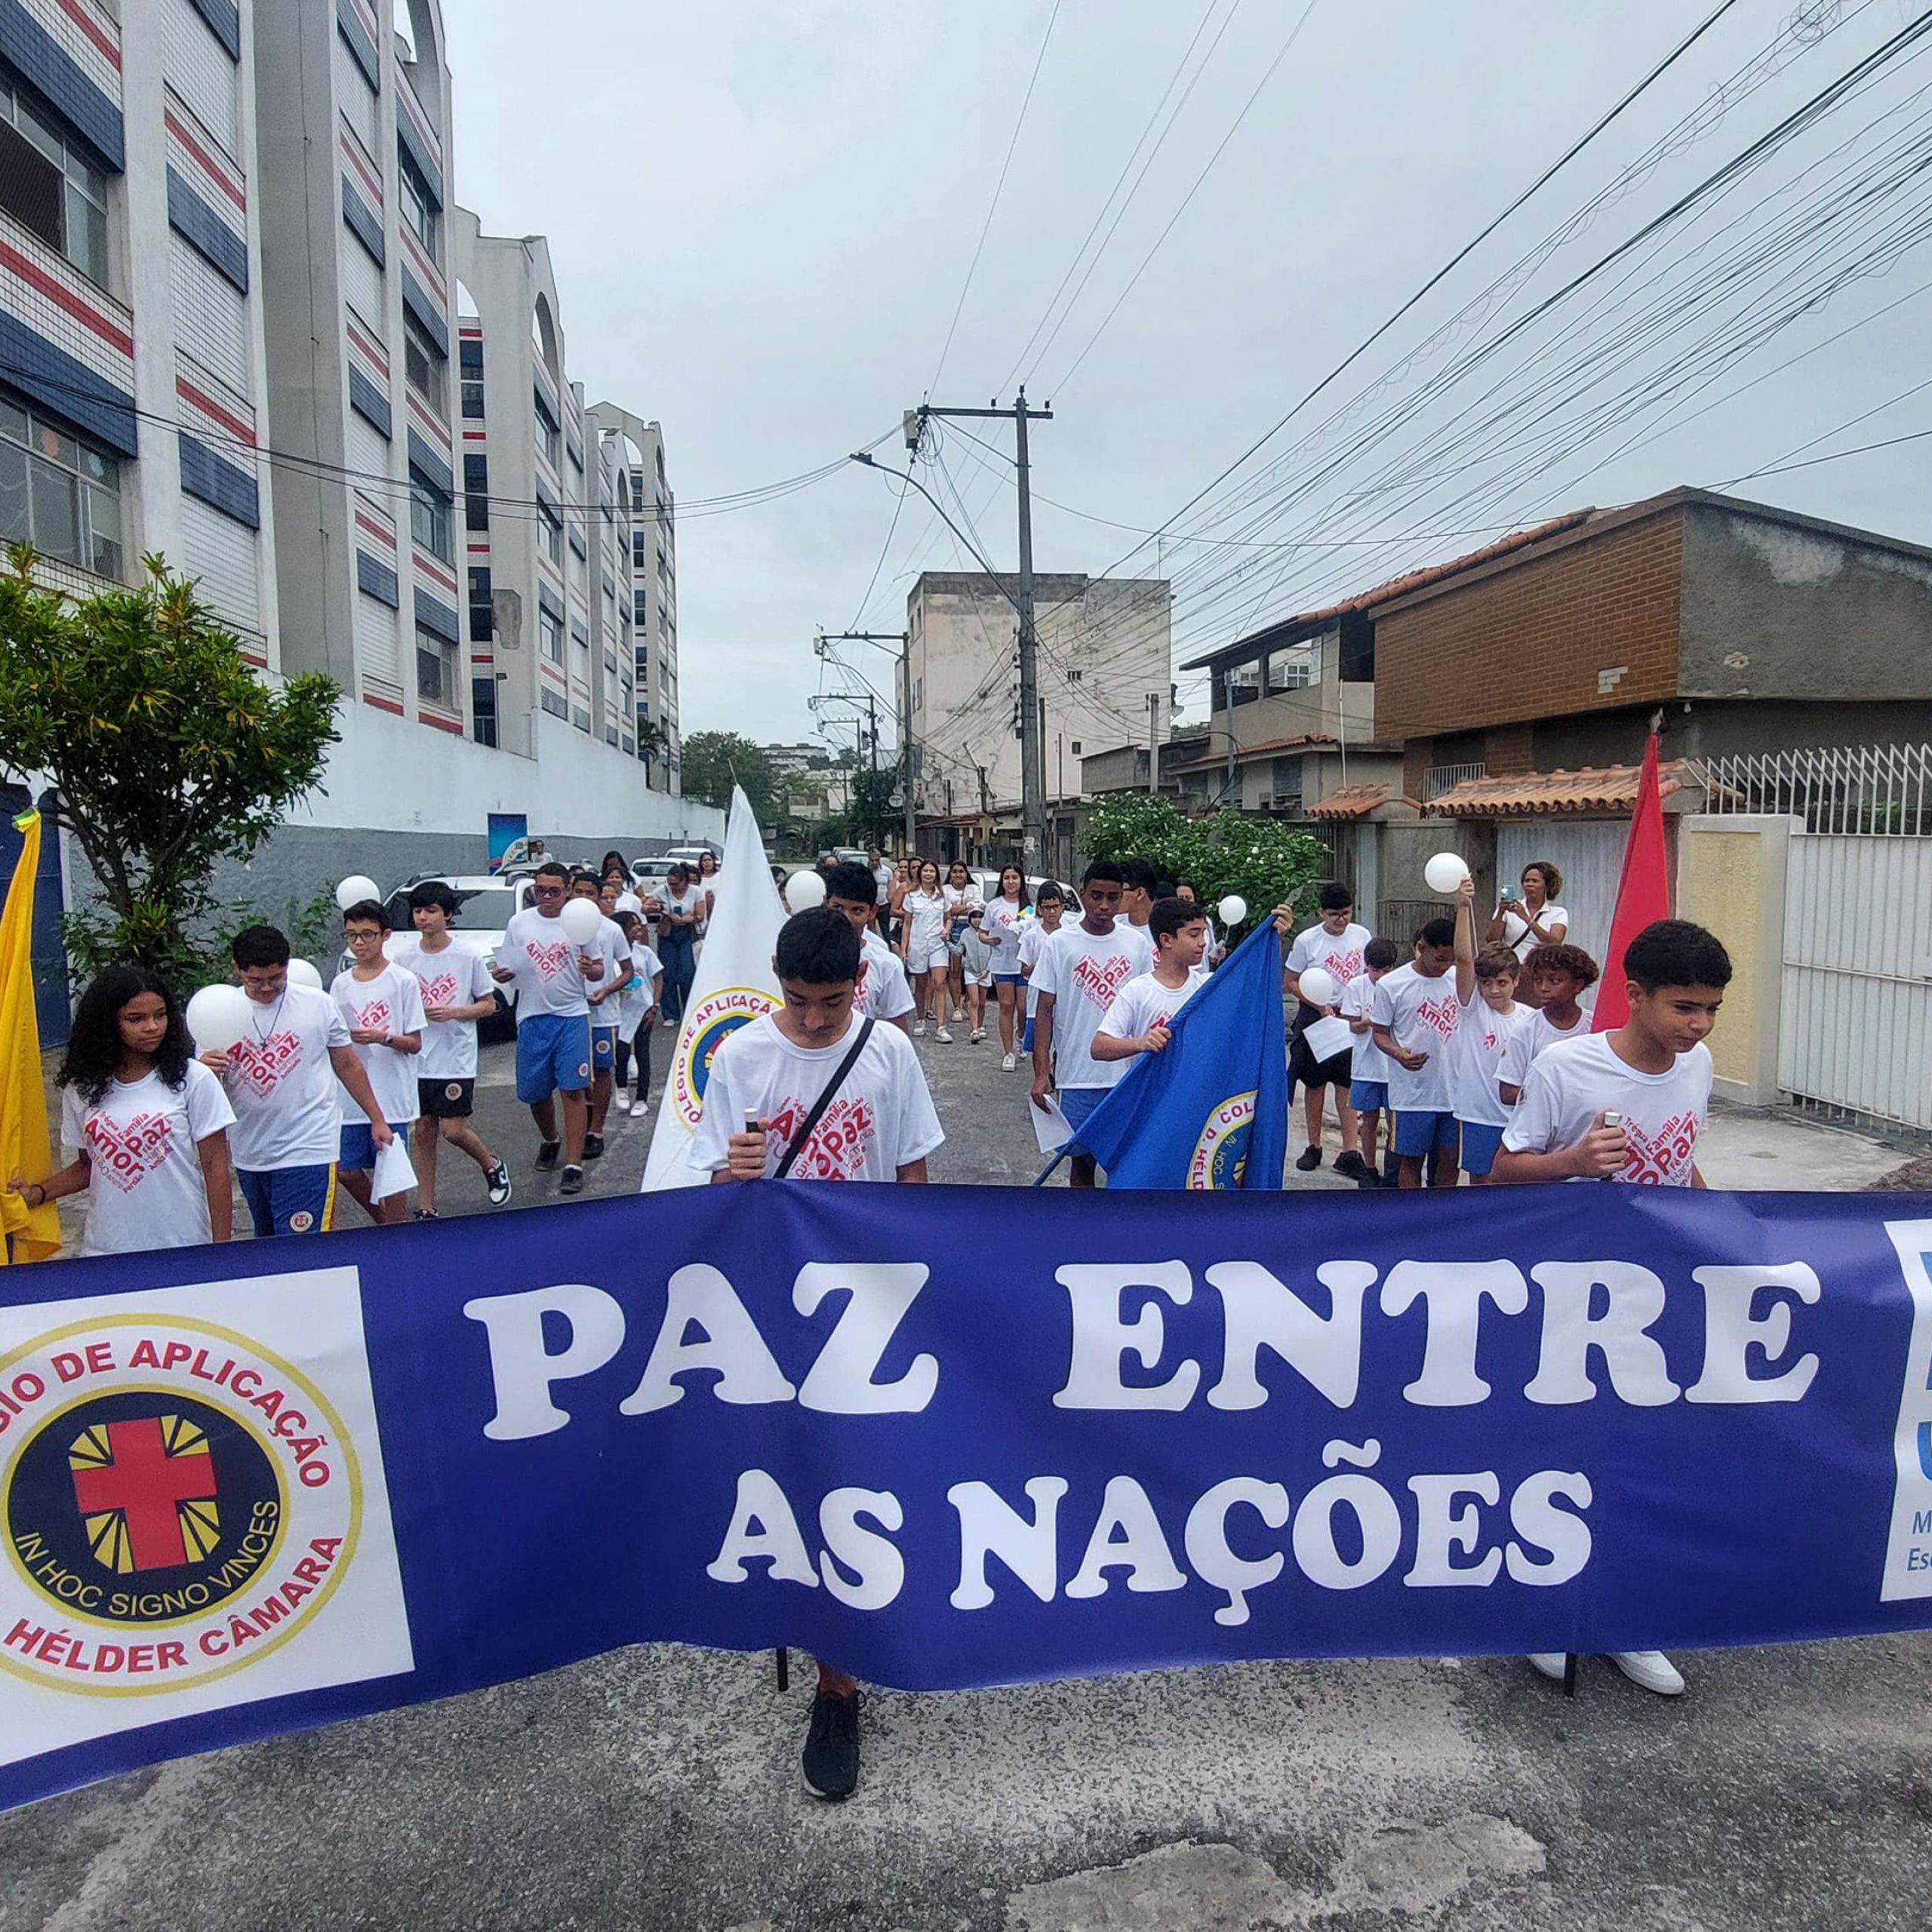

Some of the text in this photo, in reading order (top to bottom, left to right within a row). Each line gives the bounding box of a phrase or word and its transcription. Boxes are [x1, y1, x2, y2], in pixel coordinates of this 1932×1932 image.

[526, 943, 557, 974] Amor
[1103, 959, 1131, 987] Paz
[429, 977, 456, 1001] Paz
[1073, 960, 1117, 1001] Amor
[1417, 1001, 1453, 1035] Amor
[226, 1041, 278, 1085] Amor
[261, 1035, 300, 1069] Paz
[676, 994, 773, 1124] OLÉGIO DE APLICAÇÃ
[814, 1099, 849, 1138] Família
[1220, 1101, 1254, 1124] COL
[85, 1118, 146, 1177] Amor
[124, 1118, 172, 1158] Paz
[821, 1106, 872, 1163] Paz
[1645, 1115, 1681, 1155] Família
[1652, 1119, 1697, 1176] Paz
[1192, 1148, 1208, 1190] HÉLD
[463, 1258, 1821, 1441] PAZ ENTRE
[51, 1342, 116, 1384] DE
[128, 1339, 331, 1488] APLICAÇÃO
[706, 1438, 1593, 1627] AS NAÇÕES
[14, 1500, 278, 1617] IN HOC SIGNO VINCES
[3, 1535, 344, 1673] HÉLDER CÂMARA
